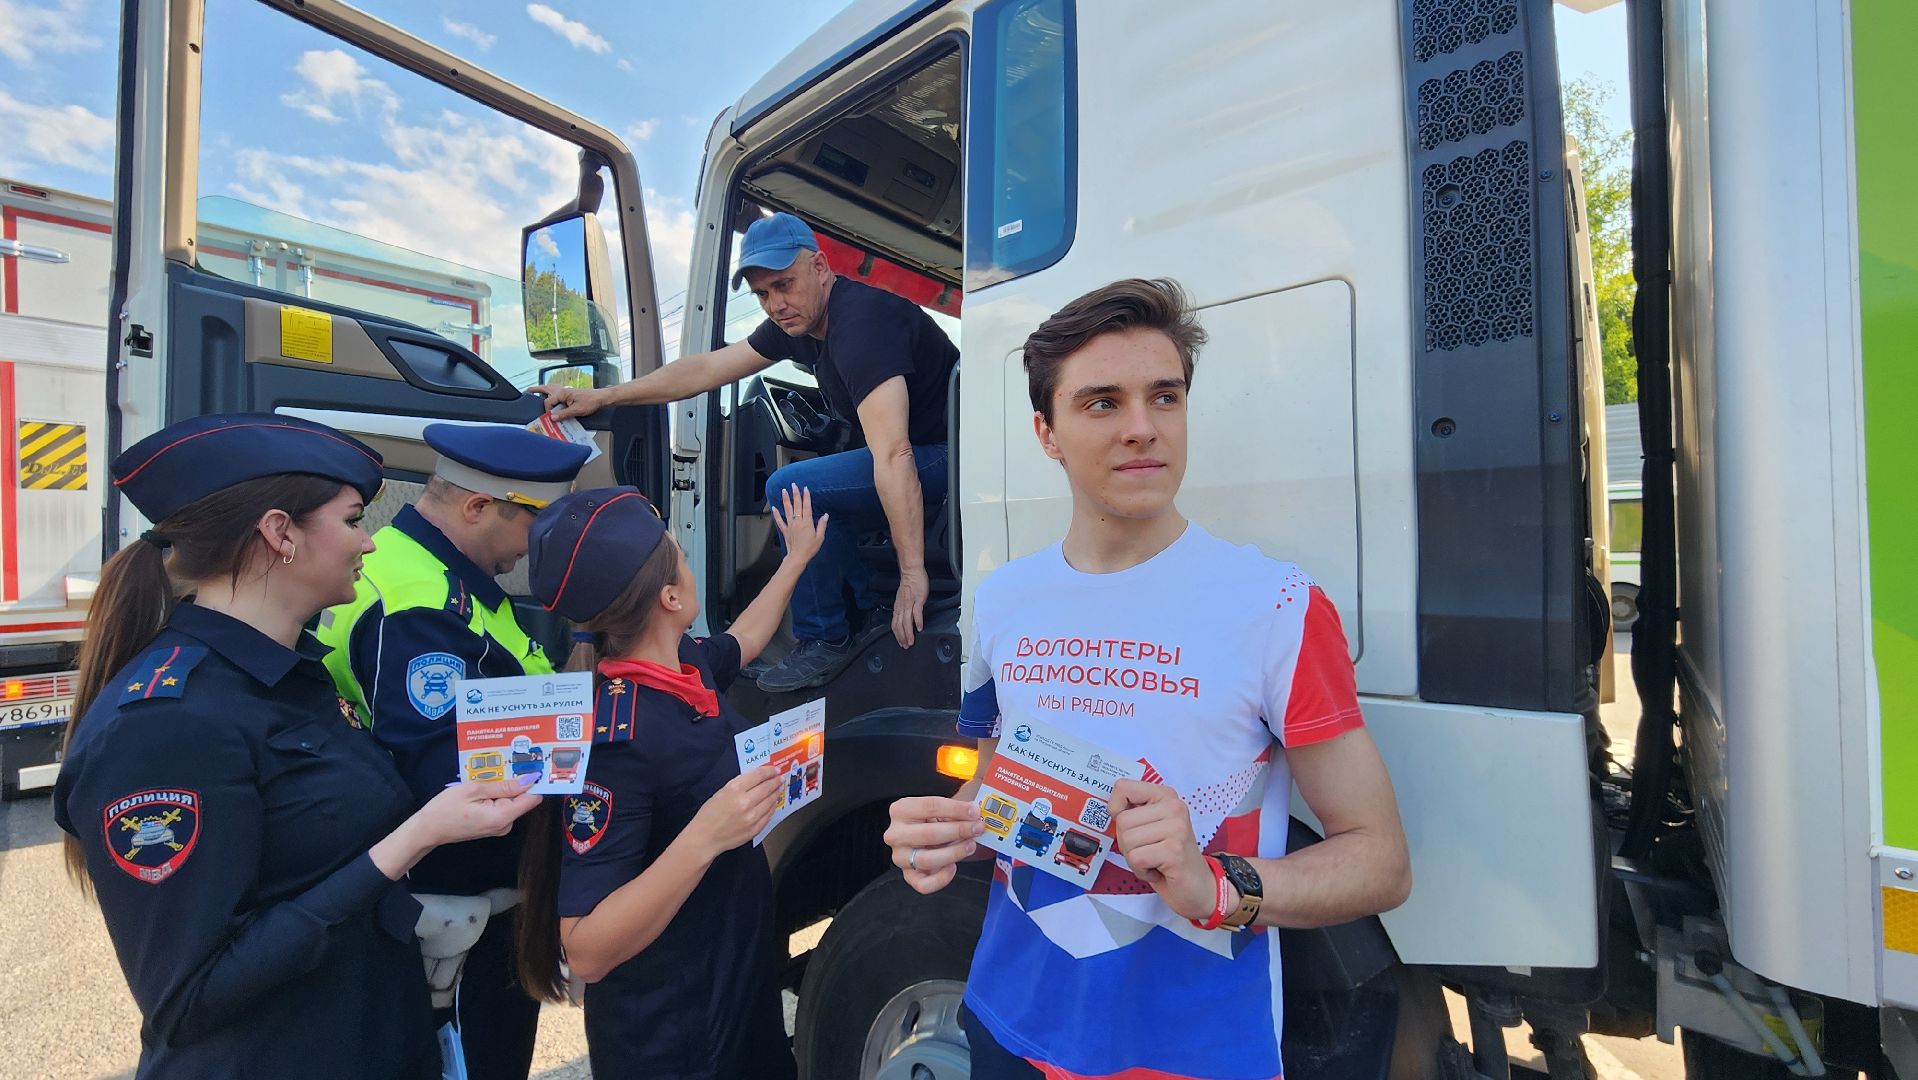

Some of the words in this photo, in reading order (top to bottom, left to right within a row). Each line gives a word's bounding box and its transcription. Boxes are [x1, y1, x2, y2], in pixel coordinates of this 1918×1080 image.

[1016, 637, 1181, 666] ВОЛОНТЕРЫ
[1001, 662, 1200, 698] ПОДМОСКОВЬЯ
[0, 704, 72, 724] У869Н
[466, 707, 486, 715] КАК
[488, 705, 500, 713] НЕ
[502, 703, 538, 712] УСНУТЬ
[553, 700, 583, 708] РУЛЕМ
[1037, 694, 1065, 710] МЫ
[1072, 696, 1135, 717] РЯДОМ
[746, 754, 759, 765] КАК
[760, 750, 767, 760] НЕ
[1007, 742, 1027, 757] КАК
[1028, 751, 1040, 762] НЕ
[1041, 757, 1077, 778] УСНУТЬ
[1077, 773, 1090, 785] ЗА
[1091, 779, 1113, 793] РУЛ
[583, 784, 609, 800] ИЦИЯ
[108, 791, 193, 818] ПОЛИЦИЯ
